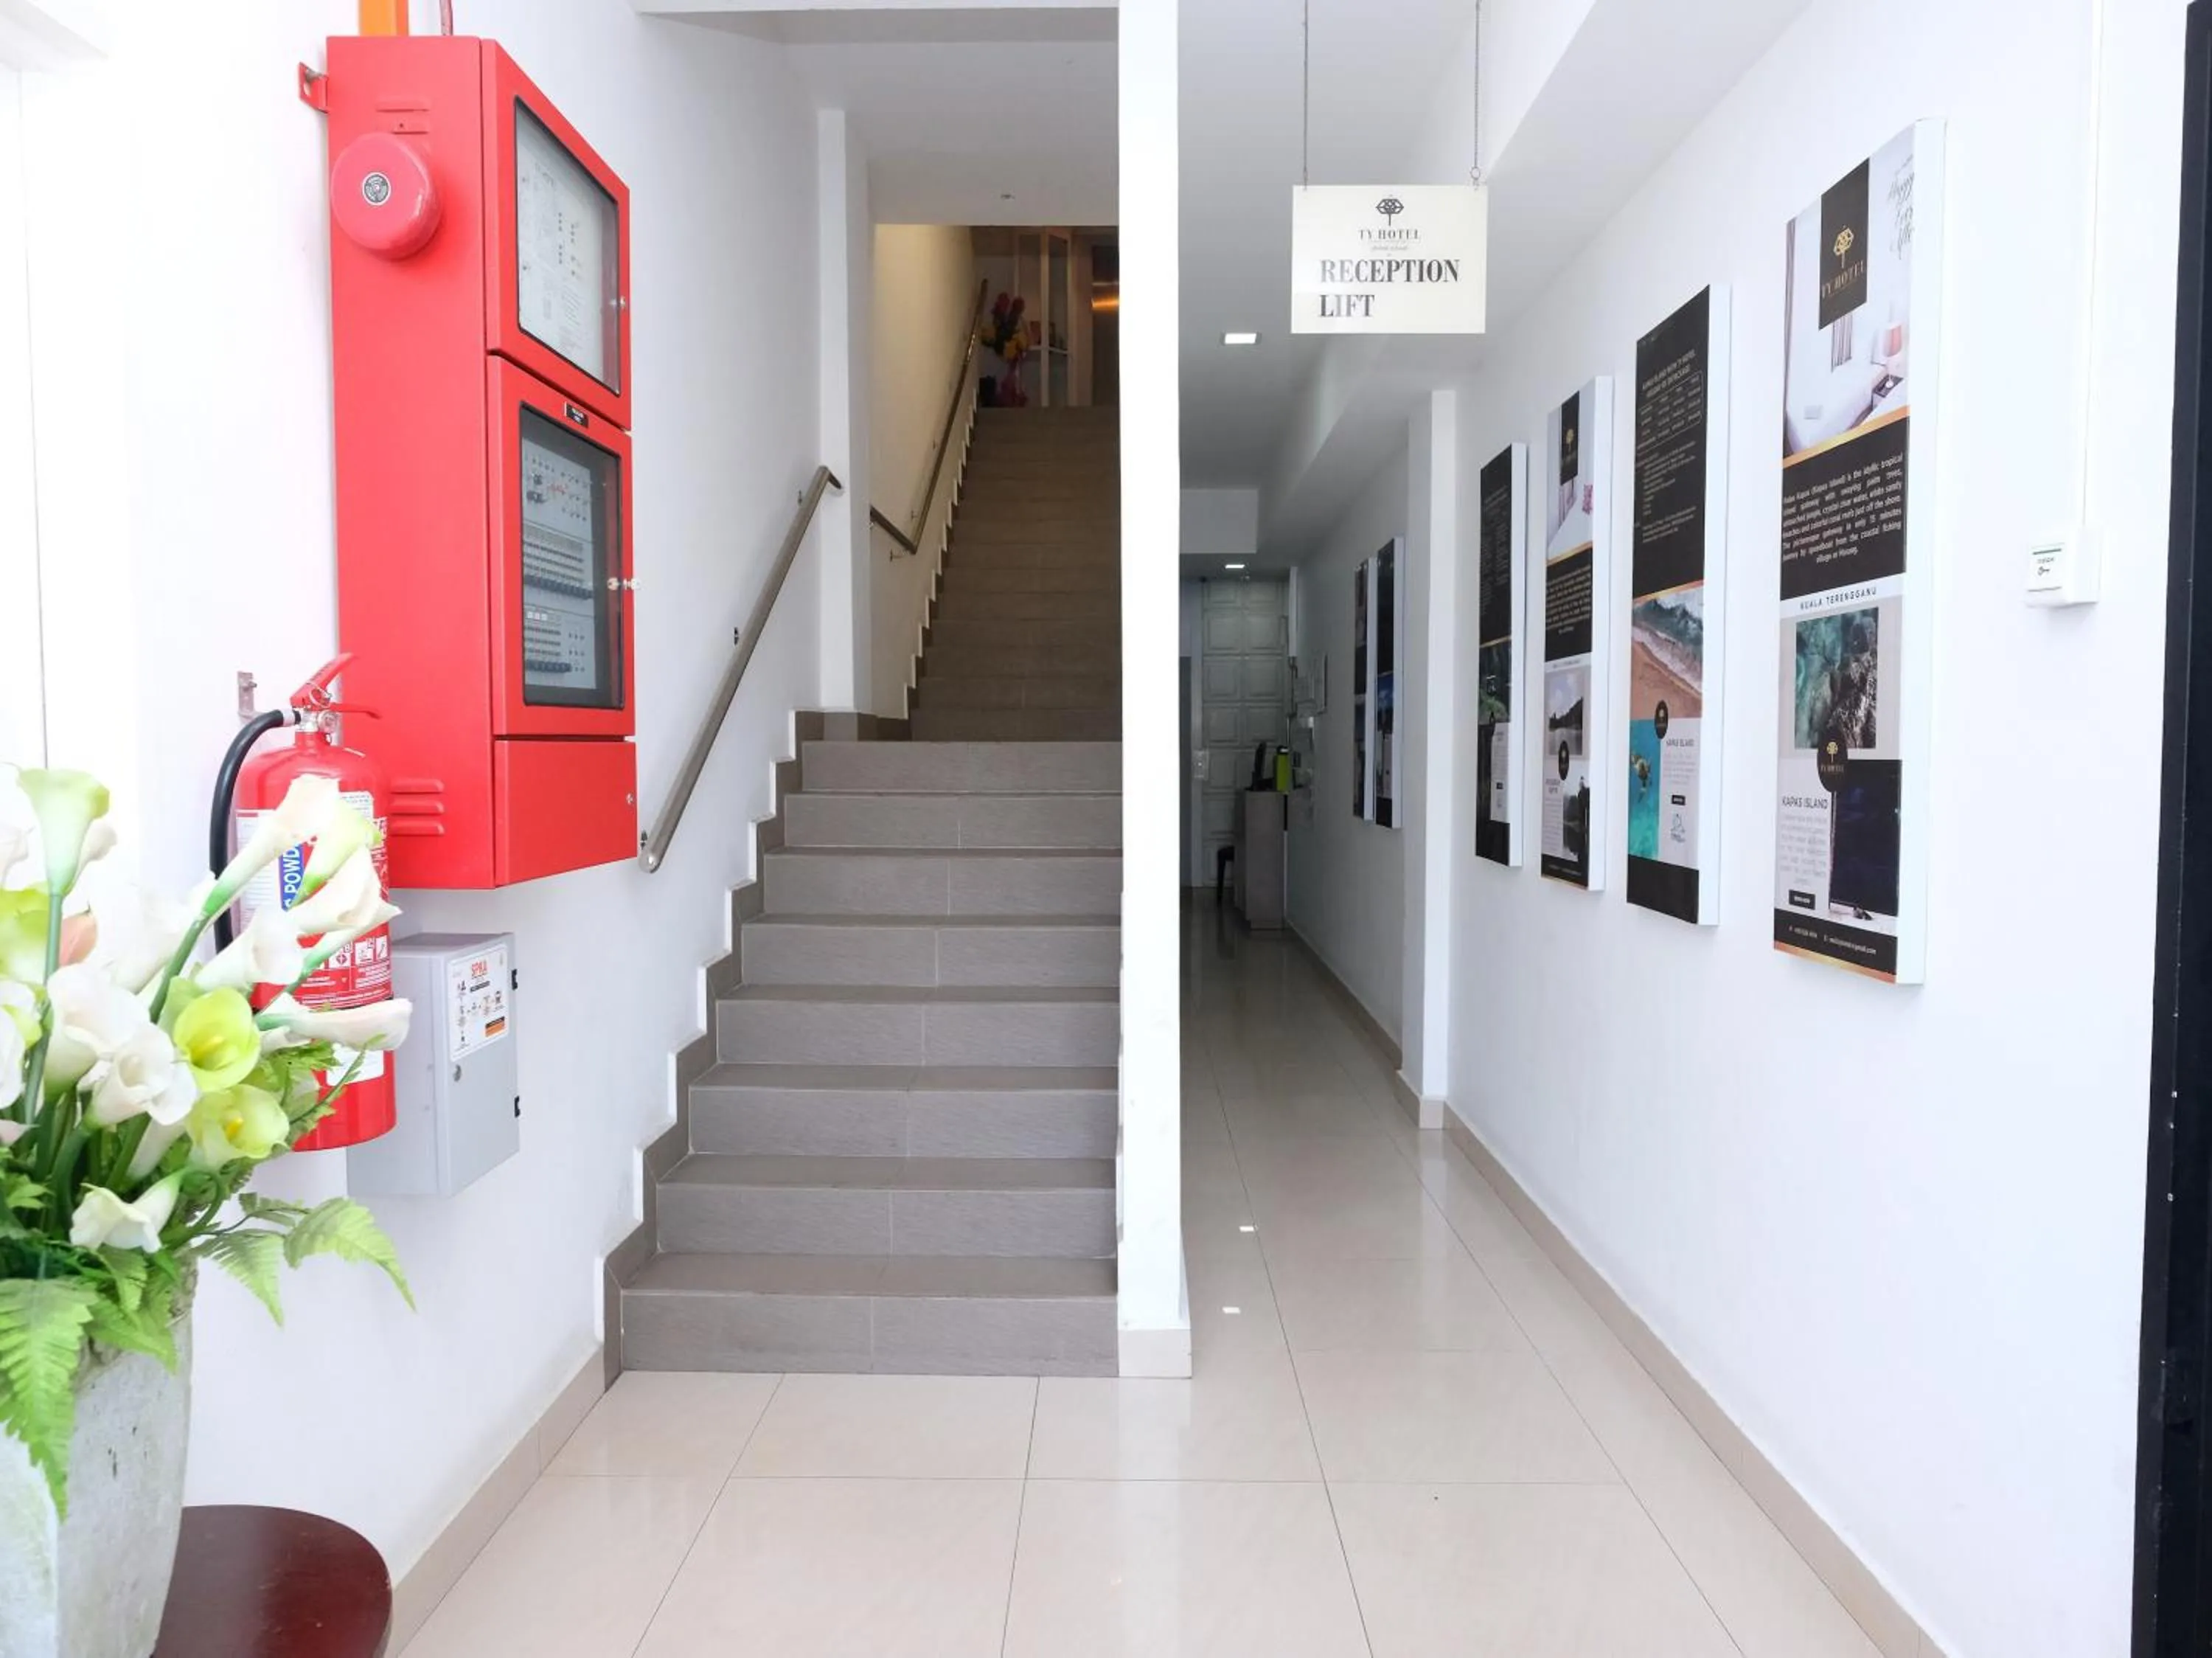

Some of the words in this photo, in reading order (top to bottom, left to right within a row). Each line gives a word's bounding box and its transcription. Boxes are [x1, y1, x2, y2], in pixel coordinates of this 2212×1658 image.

[1358, 229, 1373, 240] TY
[1378, 229, 1421, 240] HOTEL
[1320, 259, 1460, 282] RECEPTION
[1834, 260, 1866, 288] HOTEL
[1318, 294, 1375, 317] LIFT
[1826, 586, 1877, 604] TERENGGANU
[1782, 796, 1802, 808] KAPAS
[1804, 797, 1829, 809] ISLAND
[282, 843, 302, 895] POWD
